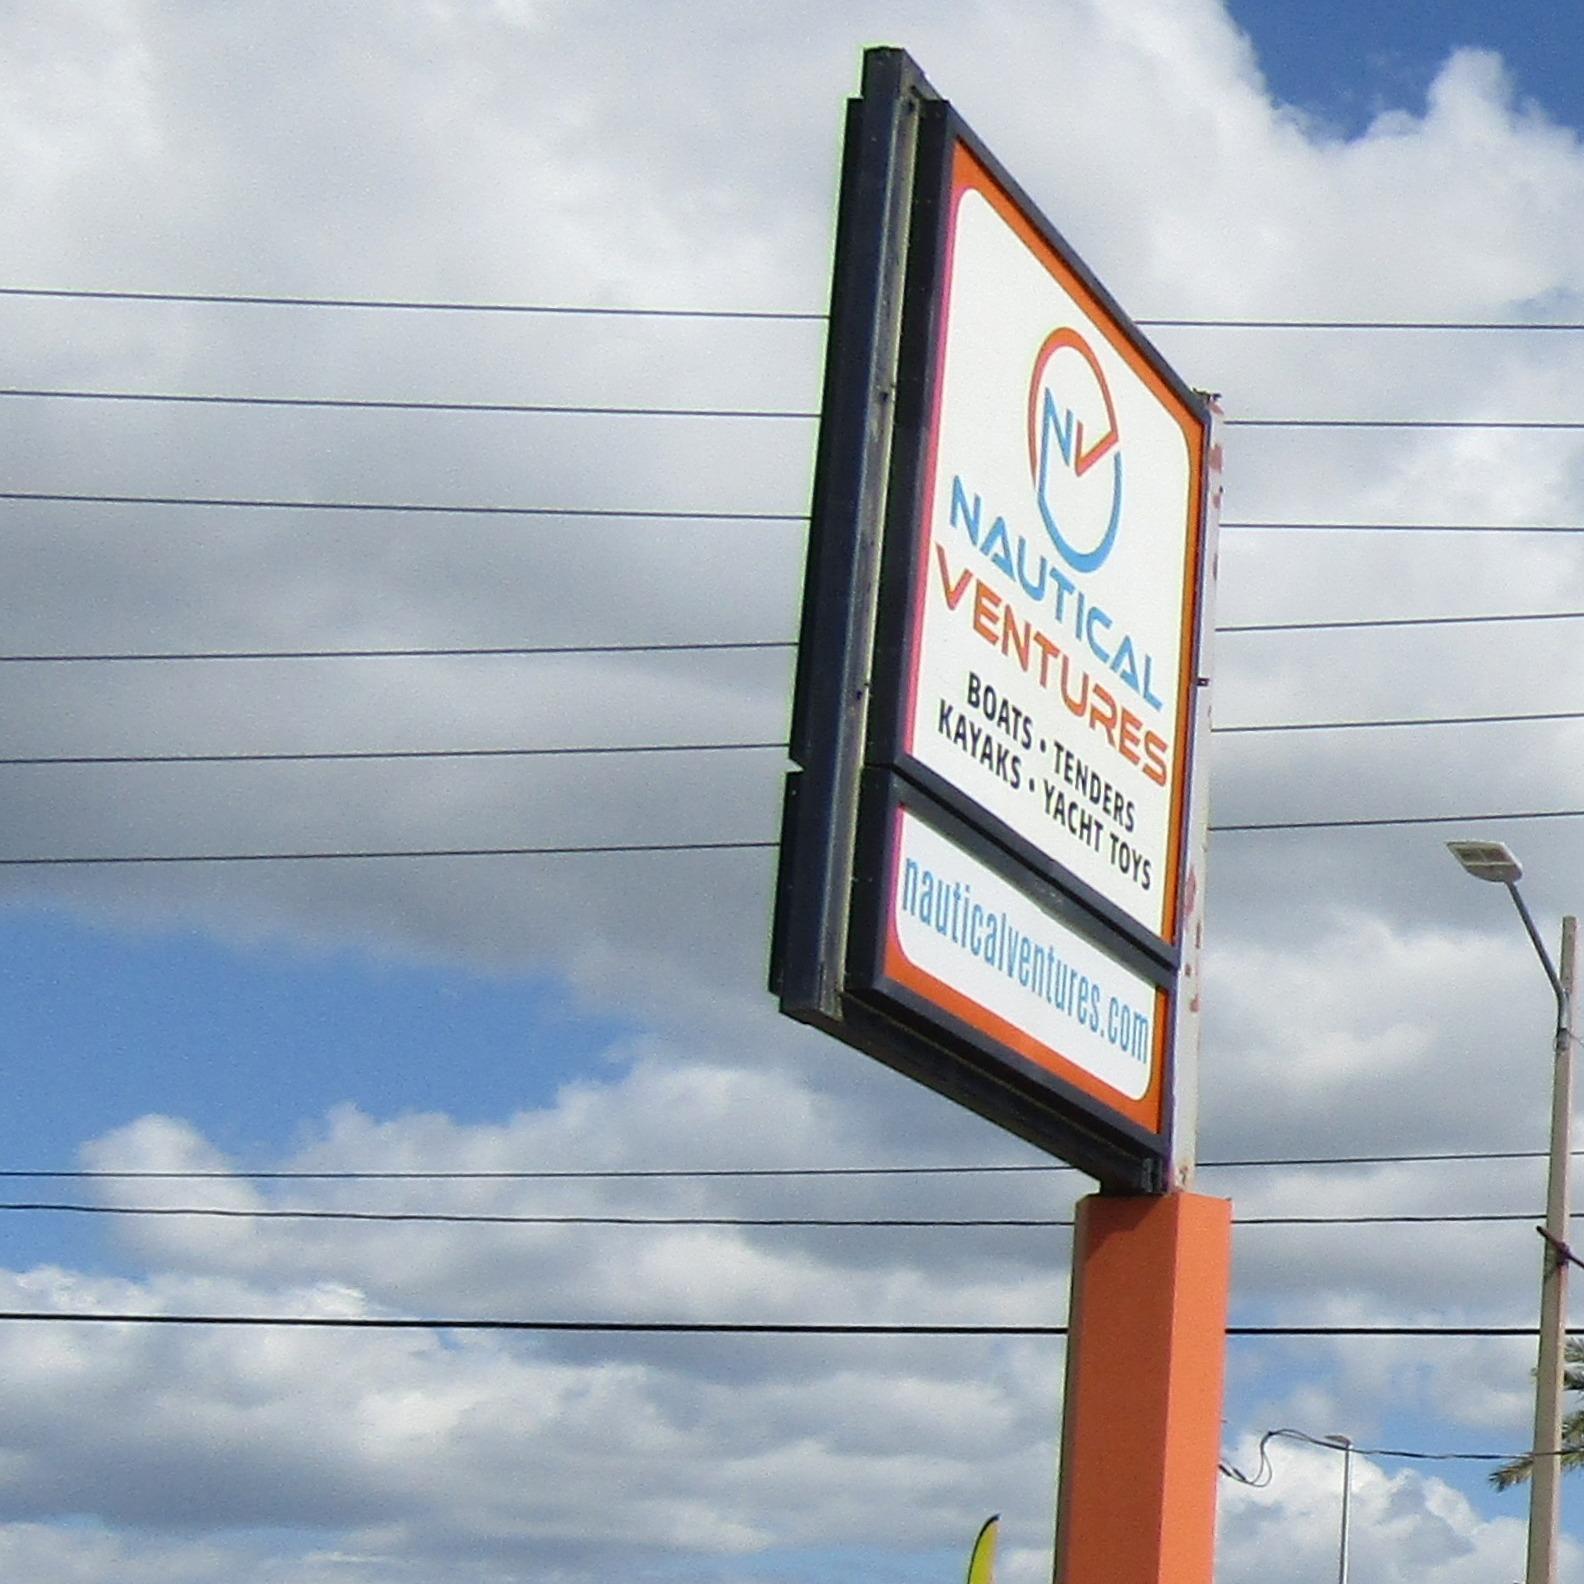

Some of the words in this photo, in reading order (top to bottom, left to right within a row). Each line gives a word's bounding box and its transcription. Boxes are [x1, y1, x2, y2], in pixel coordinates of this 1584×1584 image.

[935, 541, 1169, 787] VENTURES
[950, 474, 1163, 712] NAUTICAL
[937, 697, 1022, 790] KAYAKS
[1043, 779, 1103, 853] YACHT
[1109, 832, 1152, 891] TOYS
[967, 670, 1033, 750] BOATS
[1053, 740, 1136, 833] TENDERS
[902, 857, 1149, 1065] nauticalventures.com
